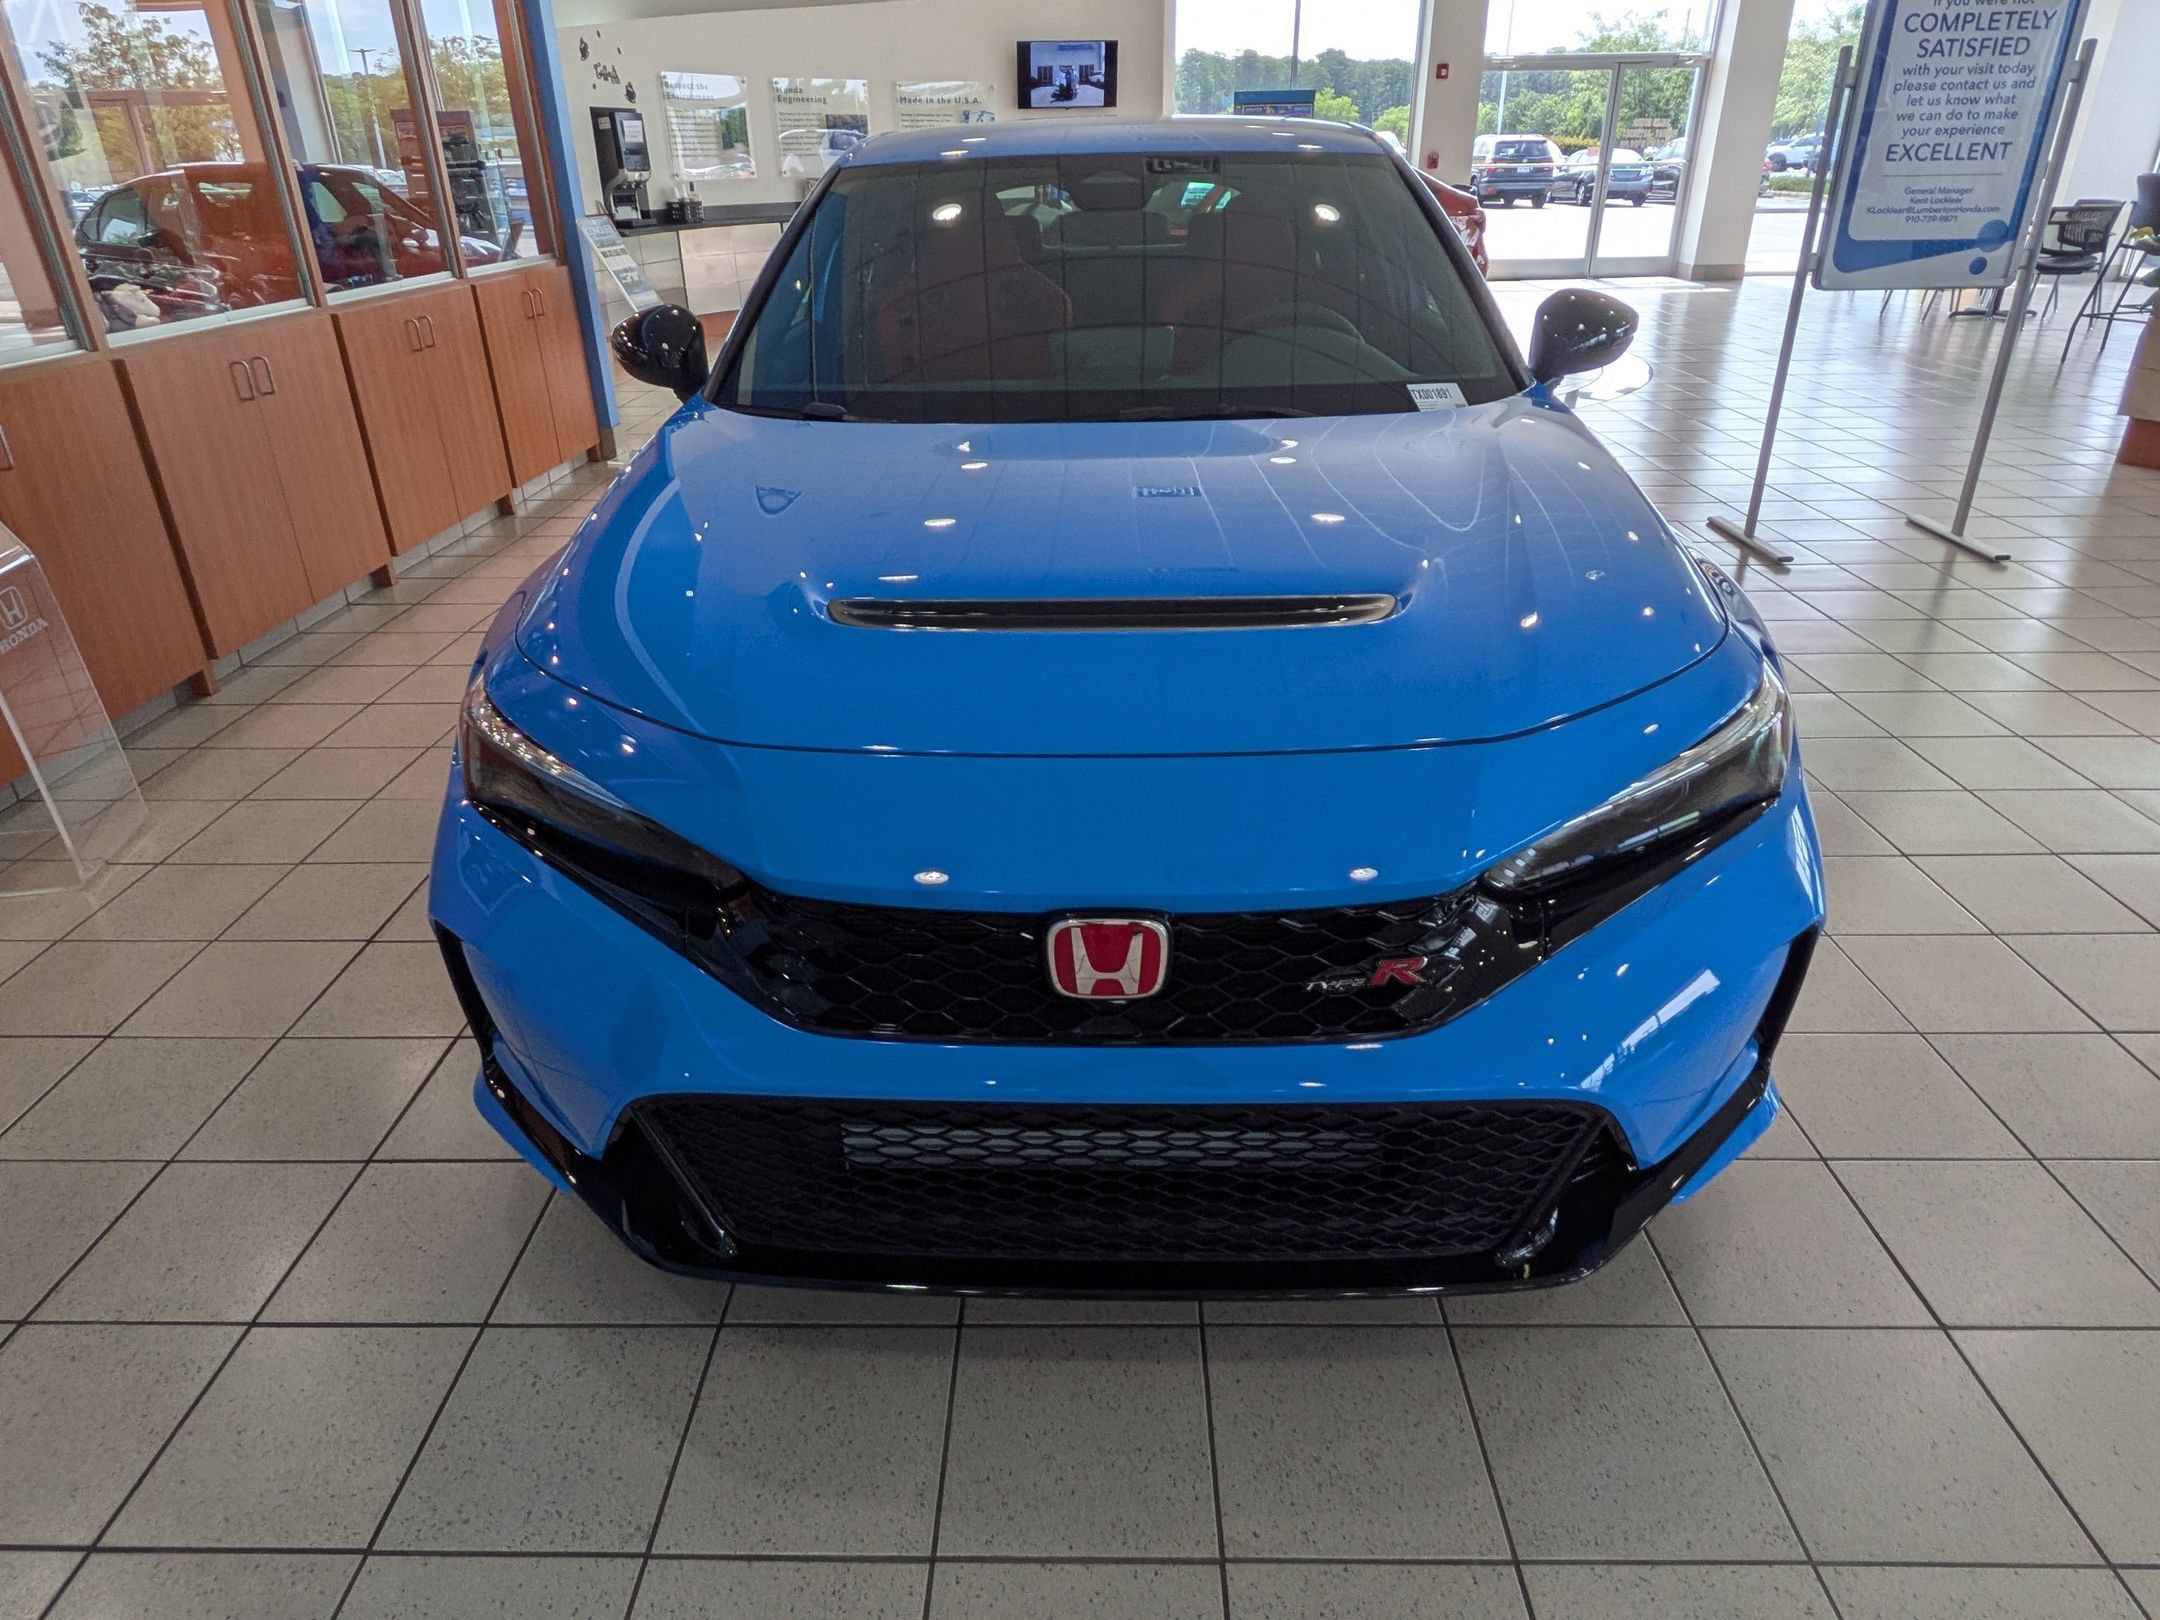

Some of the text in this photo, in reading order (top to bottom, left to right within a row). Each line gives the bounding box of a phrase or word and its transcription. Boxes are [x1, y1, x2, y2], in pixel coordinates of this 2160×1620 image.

[1904, 10, 2058, 33] COMPLETELY
[1916, 36, 2031, 58] SATISFIED
[1903, 61, 2035, 78] with your visit today
[1893, 76, 2037, 95] please contact us and
[777, 94, 827, 104] Engineering
[899, 96, 922, 104] Made
[937, 96, 952, 104] the
[954, 96, 982, 104] U.S.A.
[1906, 92, 2017, 107] let us know what
[1896, 108, 2018, 121] we can do to make
[1901, 123, 2005, 140] your experience
[1885, 142, 2014, 162] EXCELLENT
[1904, 186, 1974, 196] General Manager
